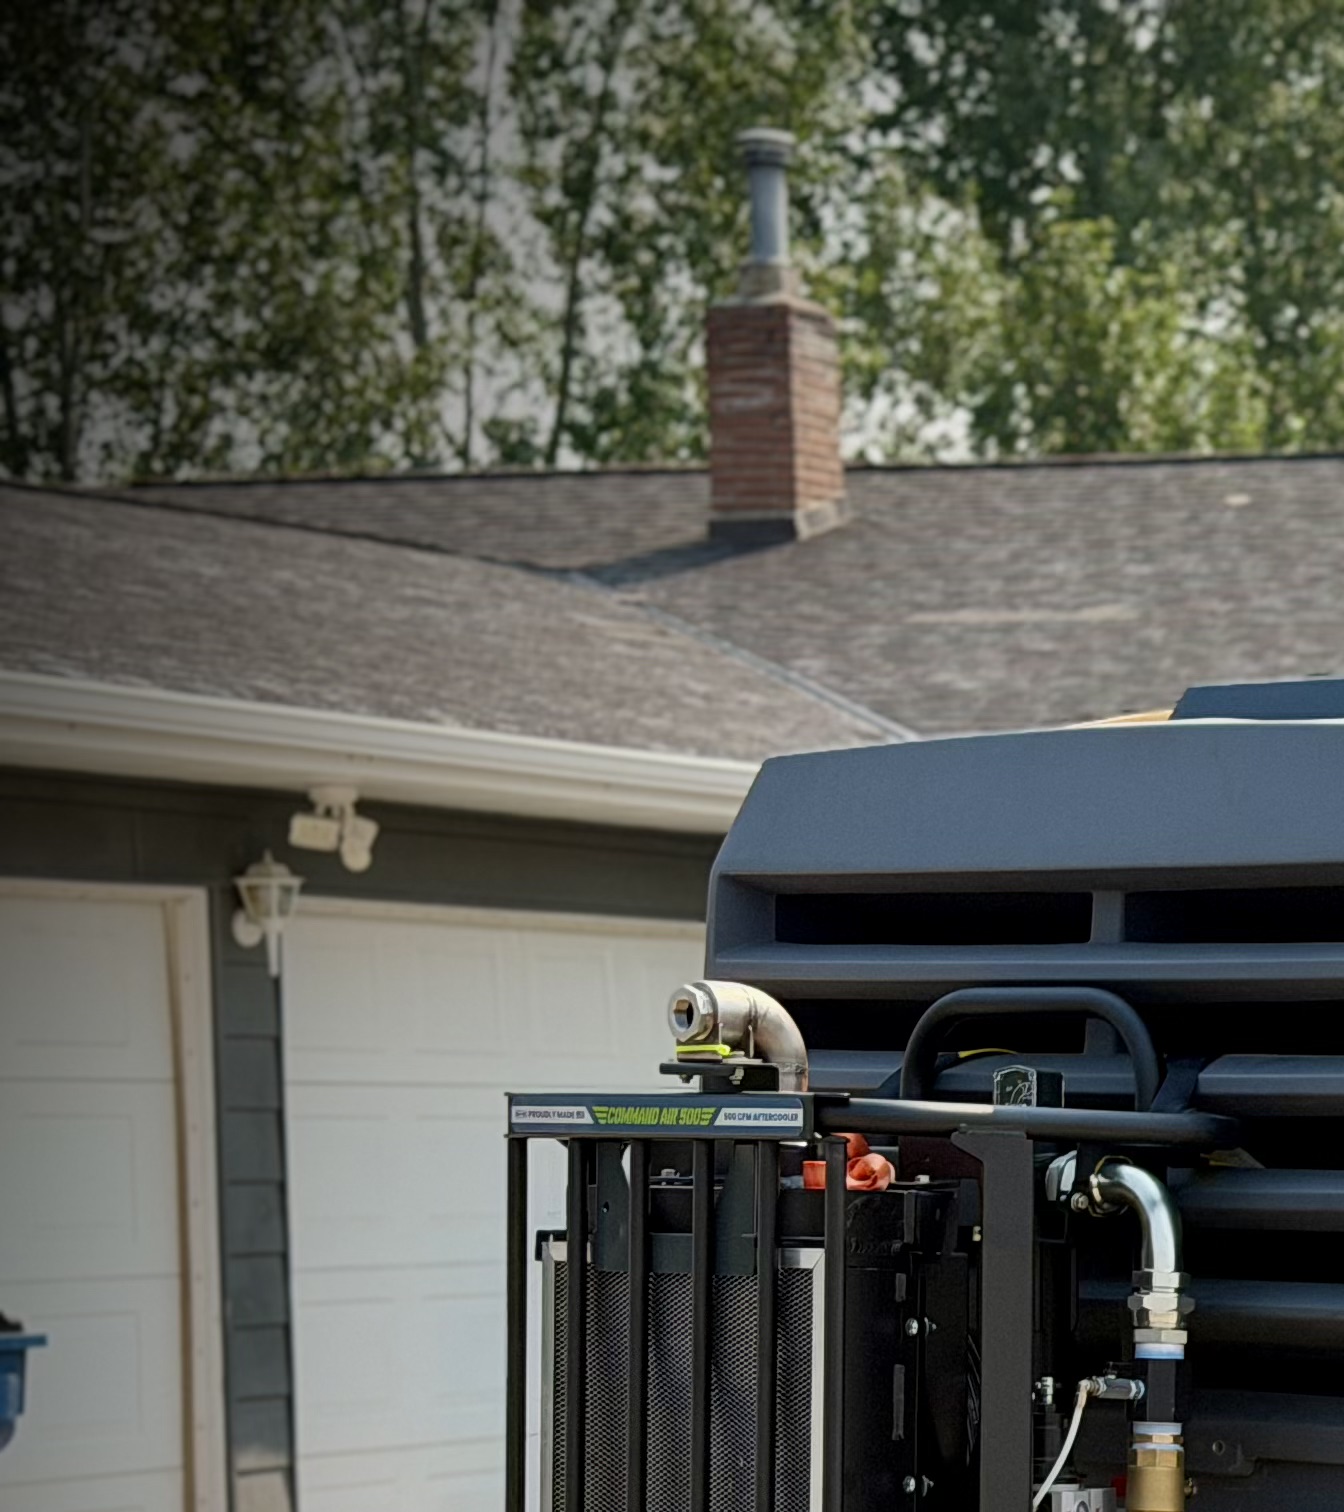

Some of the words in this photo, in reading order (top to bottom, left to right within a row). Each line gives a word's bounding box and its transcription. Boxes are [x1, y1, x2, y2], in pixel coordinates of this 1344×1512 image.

[607, 1106, 659, 1125] COMMAND
[659, 1107, 679, 1125] AIR
[679, 1107, 702, 1125] 500
[752, 1112, 799, 1122] AFTERCOOLER
